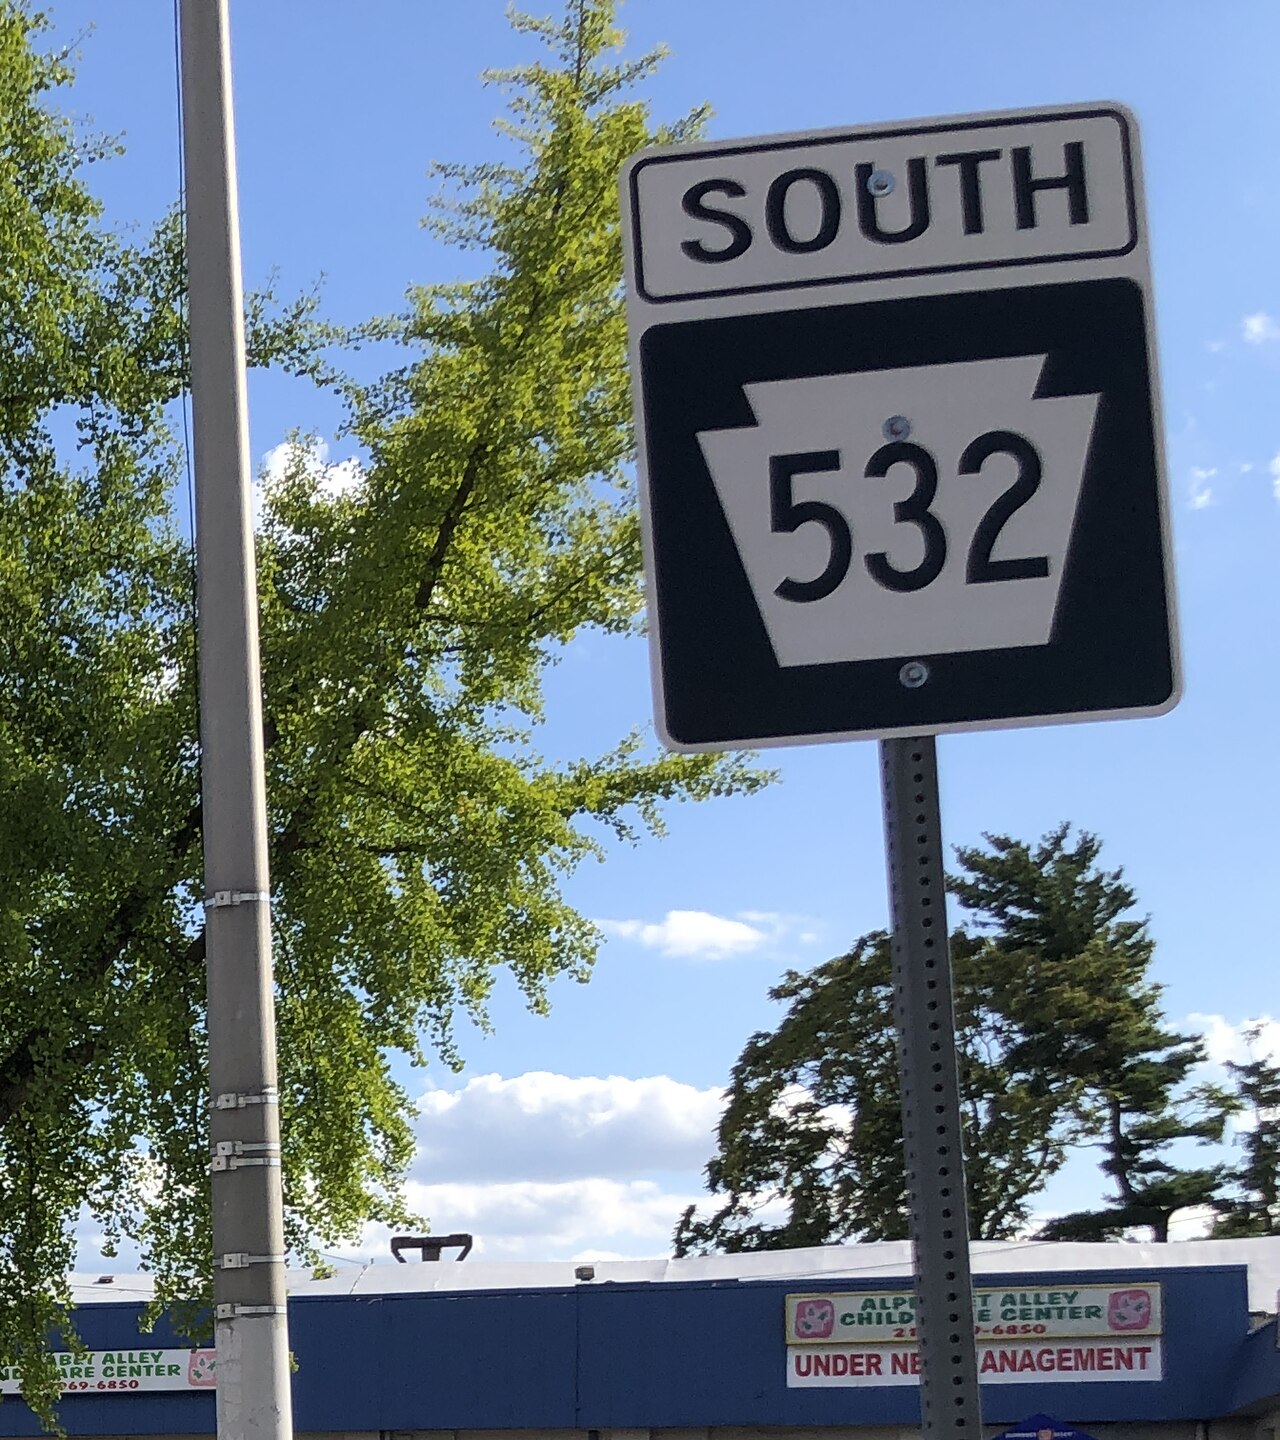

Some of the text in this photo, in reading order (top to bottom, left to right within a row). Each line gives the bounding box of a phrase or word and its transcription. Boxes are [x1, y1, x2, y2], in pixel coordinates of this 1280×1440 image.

[681, 141, 1090, 263] SOUTH
[769, 431, 1050, 603] 532
[1000, 1291, 1079, 1307] ALLEY
[840, 1312, 915, 1327] CHILD
[1001, 1305, 1103, 1322] CENTER
[102, 1351, 164, 1365] ALLEY
[794, 1347, 1152, 1378] UNDER NE ANAGEMENT
[102, 1364, 181, 1378] CENTER
